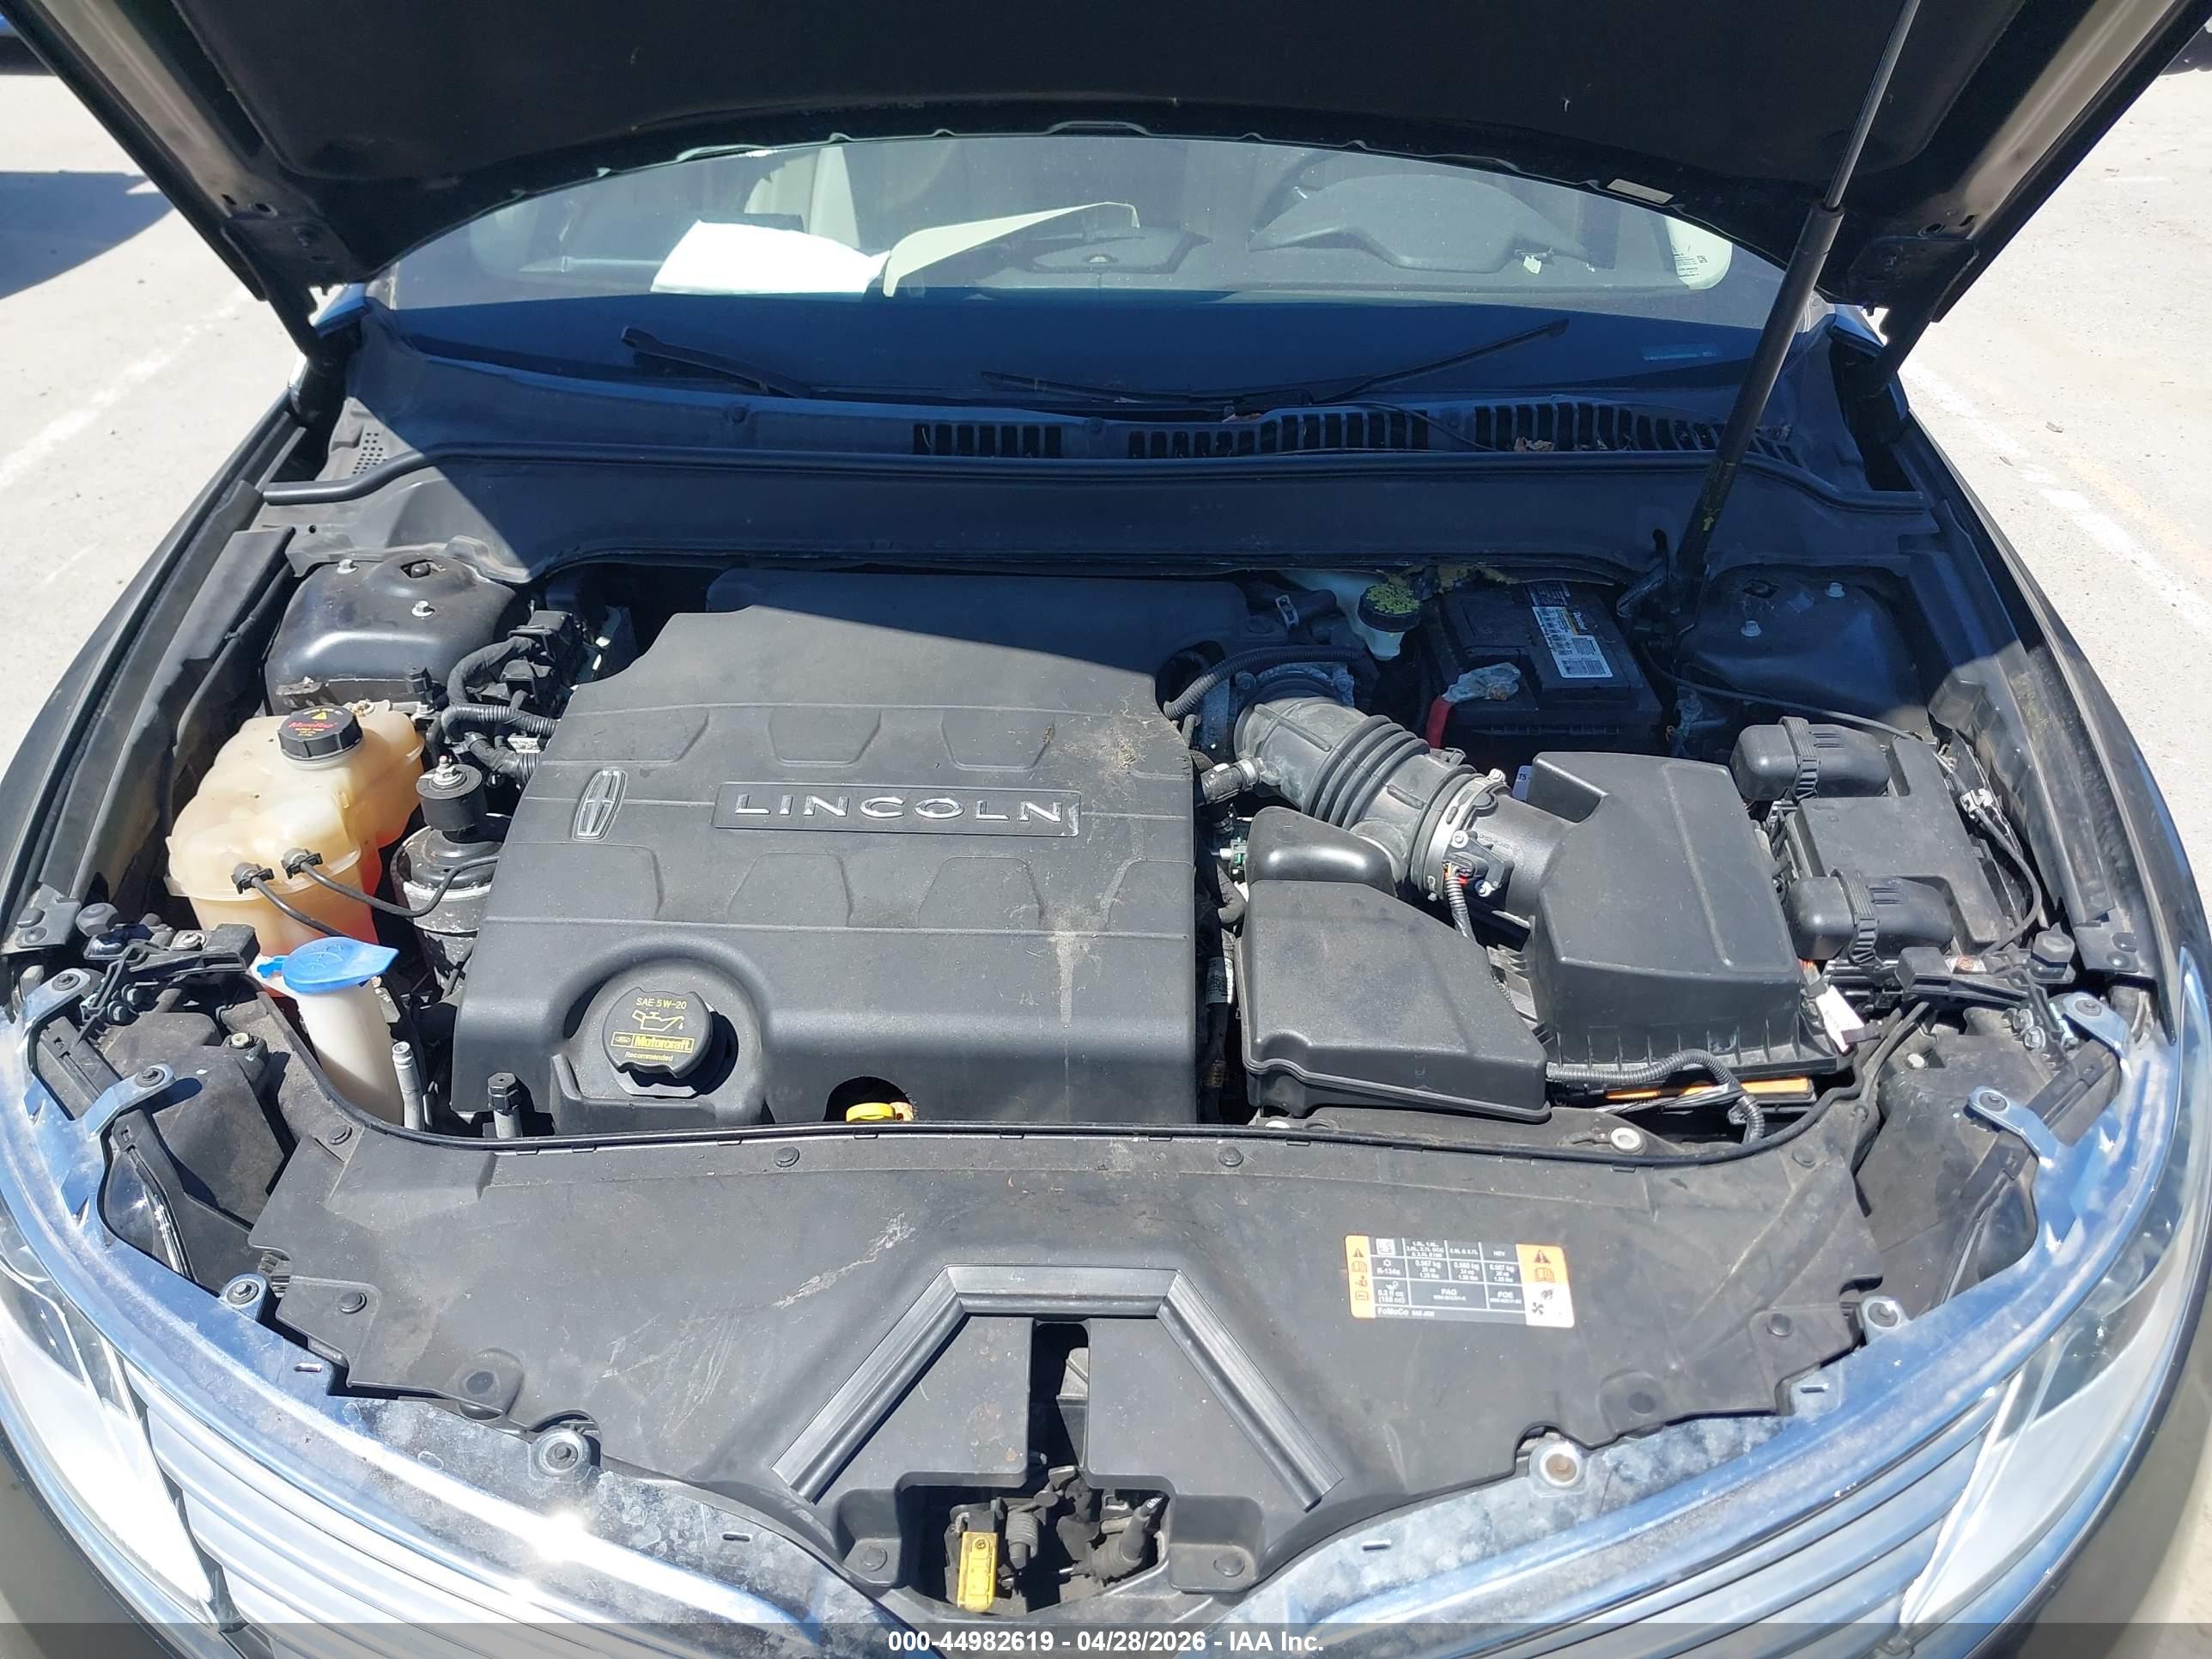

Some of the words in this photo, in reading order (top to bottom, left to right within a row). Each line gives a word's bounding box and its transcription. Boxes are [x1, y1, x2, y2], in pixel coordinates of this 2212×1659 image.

[734, 793, 1063, 823] LINCOLN
[635, 997, 653, 1007] SAE
[656, 999, 687, 1010] 5W-20
[635, 1035, 690, 1052] Motorcraft
[625, 1051, 674, 1062] Recommended
[1432, 1261, 1441, 1269] kg
[1471, 1262, 1480, 1271] kg
[1377, 1307, 1408, 1316] FoMoCo
